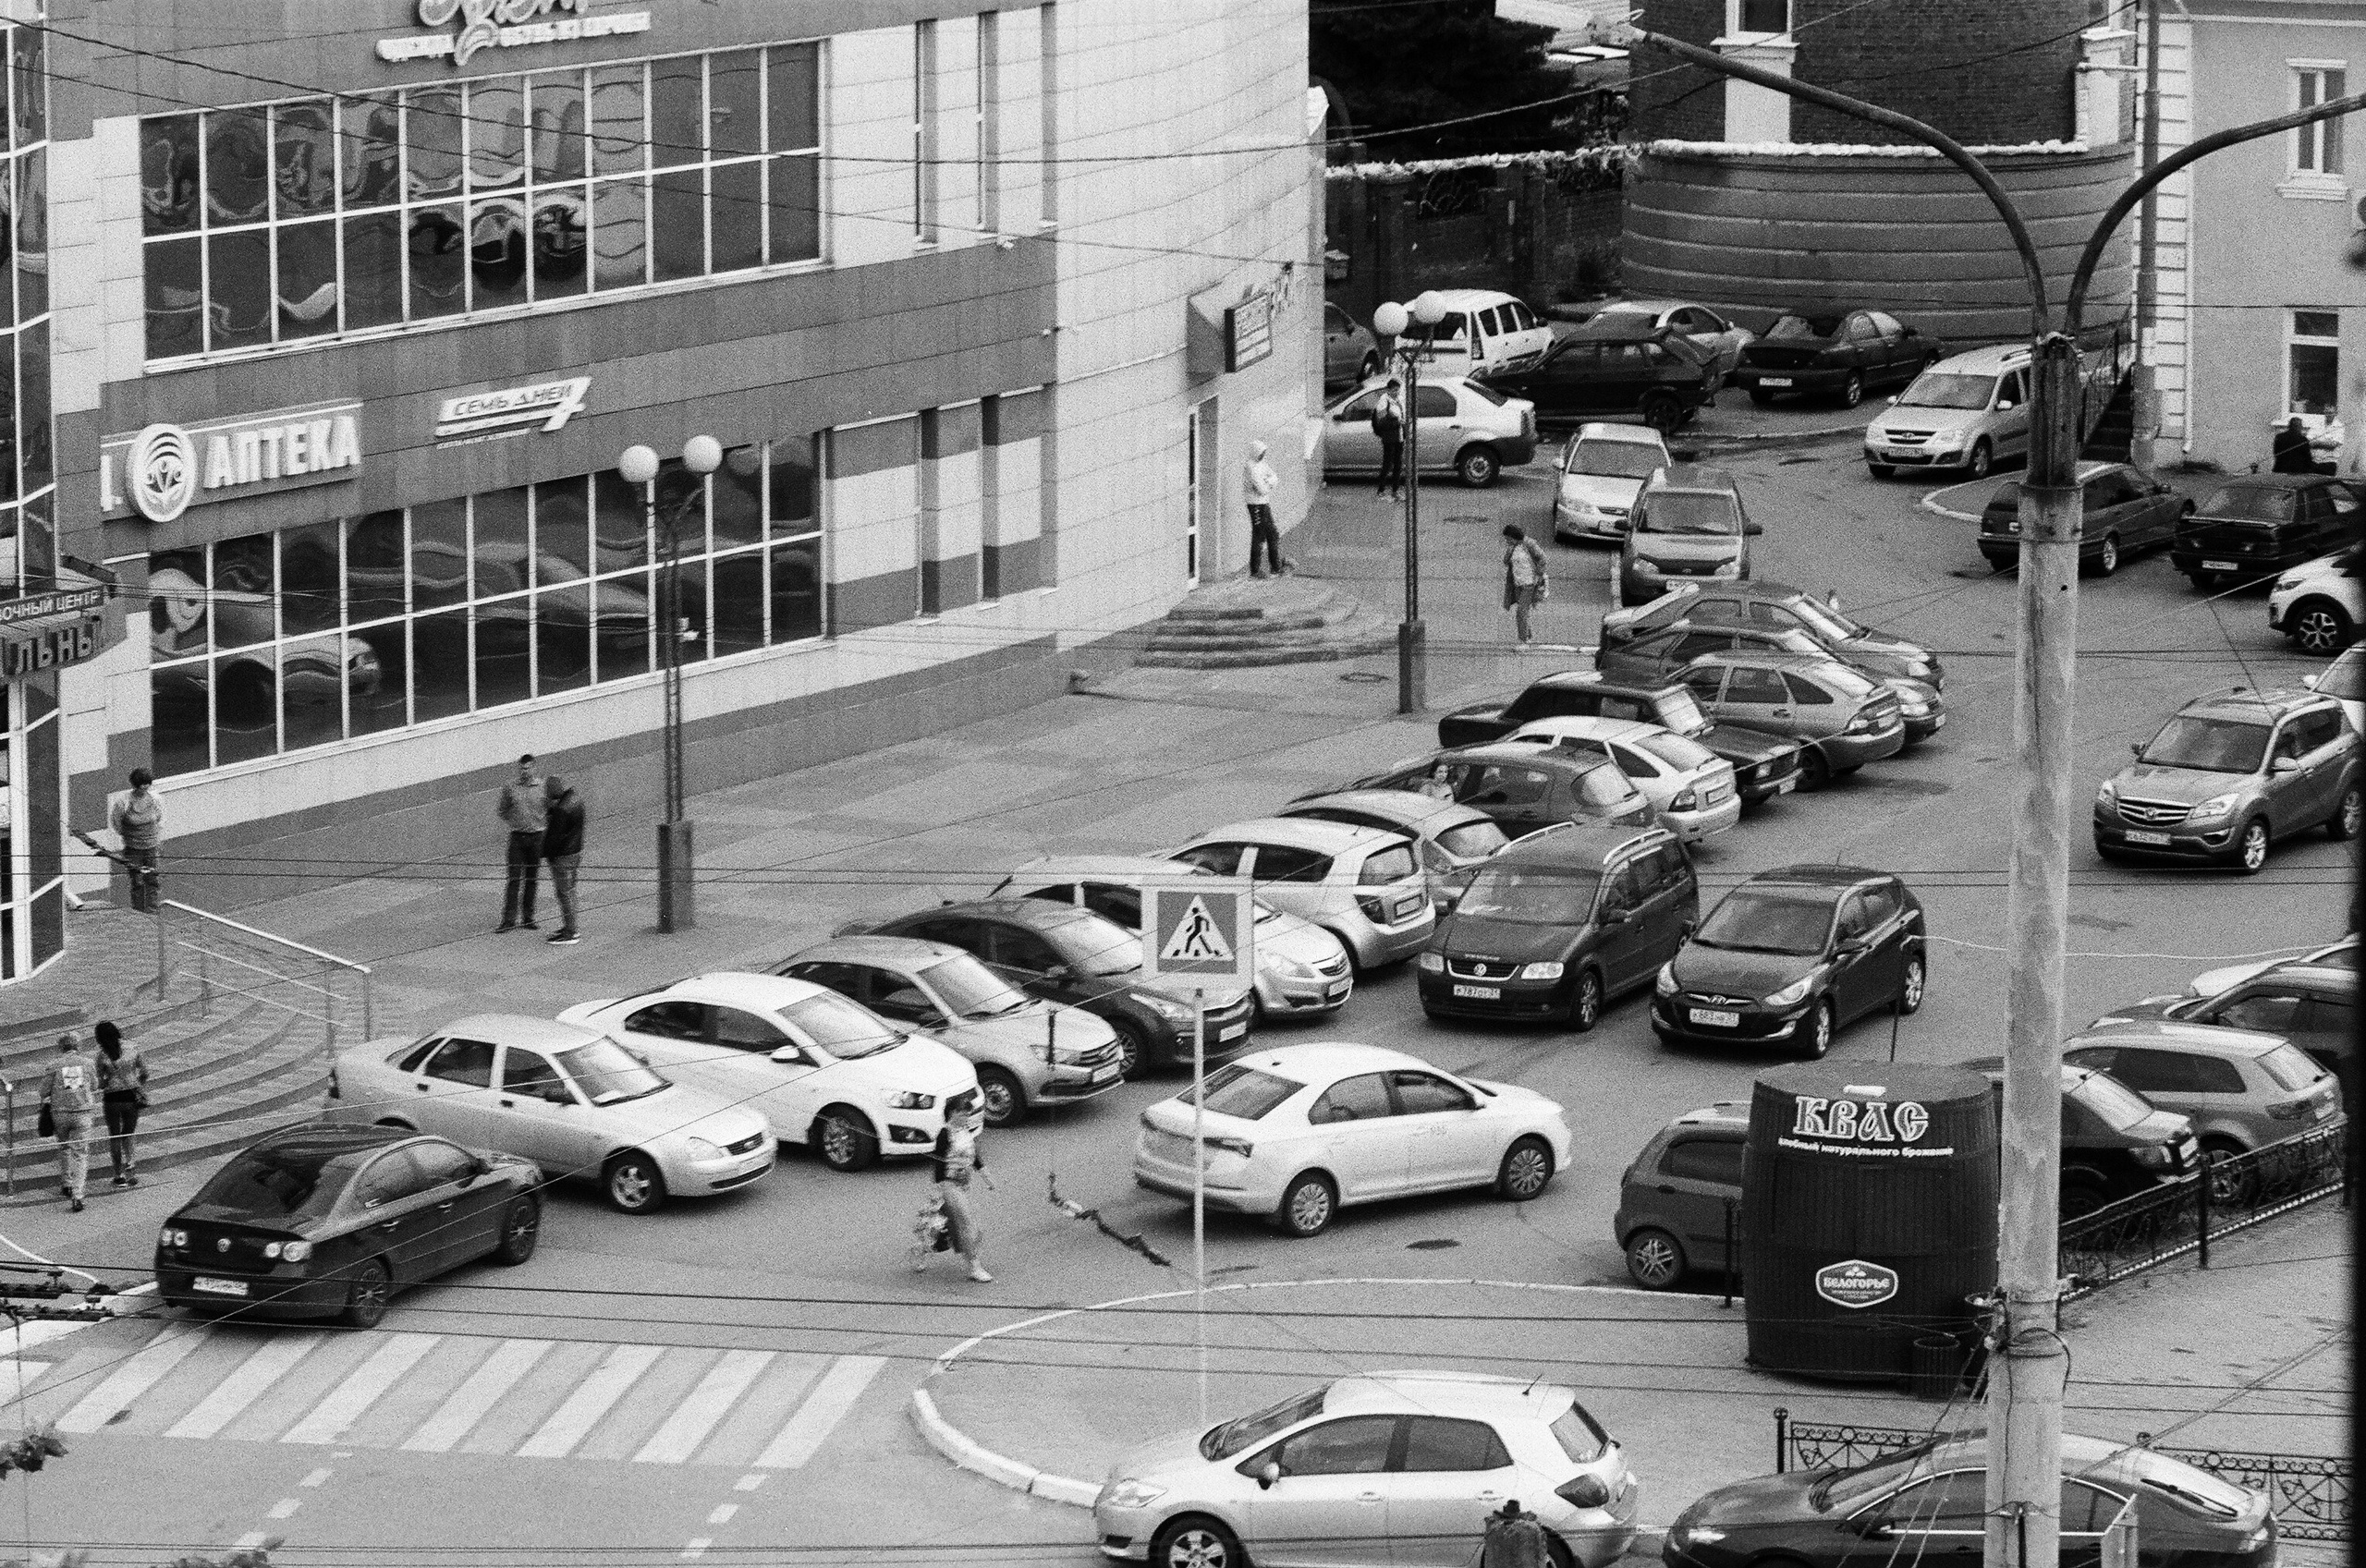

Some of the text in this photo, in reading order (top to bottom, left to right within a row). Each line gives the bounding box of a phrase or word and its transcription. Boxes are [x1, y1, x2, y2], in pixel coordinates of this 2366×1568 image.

[203, 415, 361, 489] АПТЕКА
[0, 590, 101, 621] ОЧНЫЙ ЦЕНТР
[1792, 1096, 1929, 1142] КВАС
[1821, 1145, 1899, 1157] натурального
[1823, 1277, 1890, 1289] БЕЛОГОРЬЕ
